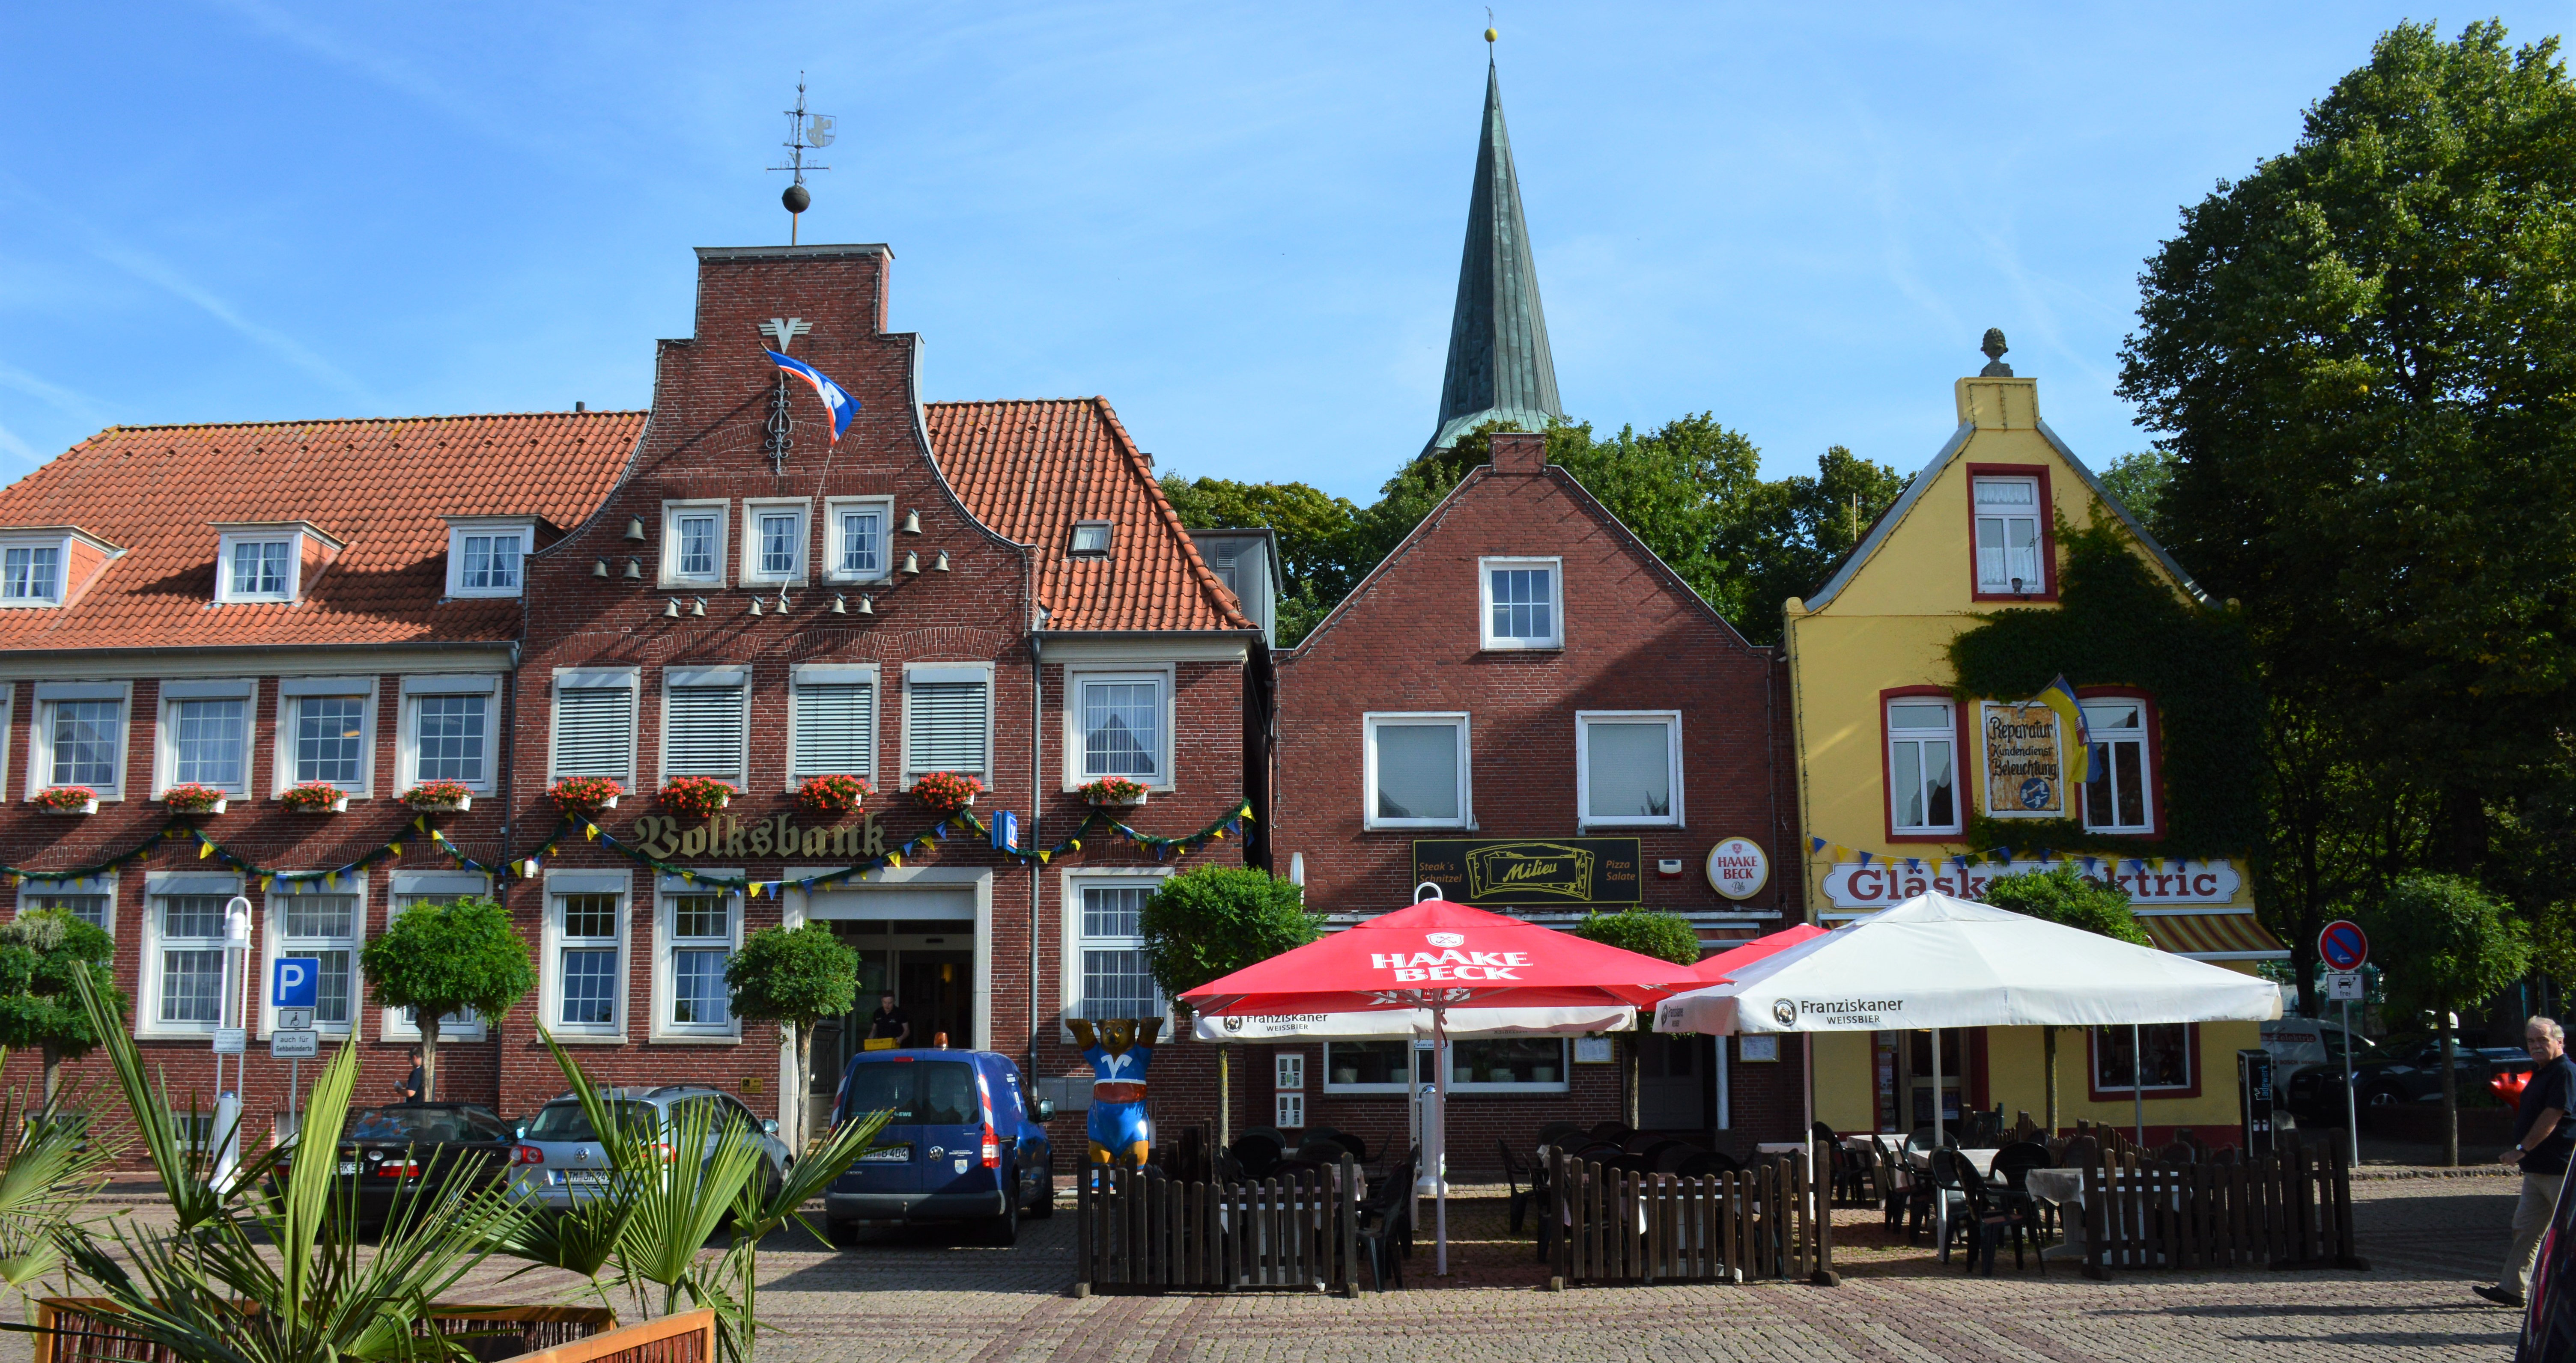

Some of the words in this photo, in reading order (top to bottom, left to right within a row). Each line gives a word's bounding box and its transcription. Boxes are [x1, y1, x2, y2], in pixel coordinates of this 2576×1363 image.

[1989, 716, 2053, 743] Reparatur
[1991, 743, 2053, 757] Kundendienst
[1992, 758, 2057, 781] Beleuchtung
[634, 812, 887, 859] Volksbank
[1606, 860, 1630, 869] Pizza
[1718, 856, 1758, 867] HAAKE
[1503, 859, 1557, 882] Milieu
[1606, 872, 1636, 881] Salate
[1723, 868, 1754, 879] BECK
[1419, 874, 1462, 883] Schnitzel
[1731, 881, 1746, 893] Pils
[1371, 949, 1534, 969] HAAKE
[1394, 965, 1524, 982] BECK
[279, 964, 304, 1001] P
[1801, 999, 1903, 1013] Franziskaner
[1827, 1015, 1881, 1024] WEISSBIER
[1266, 1024, 1309, 1032] WEISSBIER
[2258, 1065, 2271, 1100] Ladewerk
[890, 1148, 906, 1156] 404
